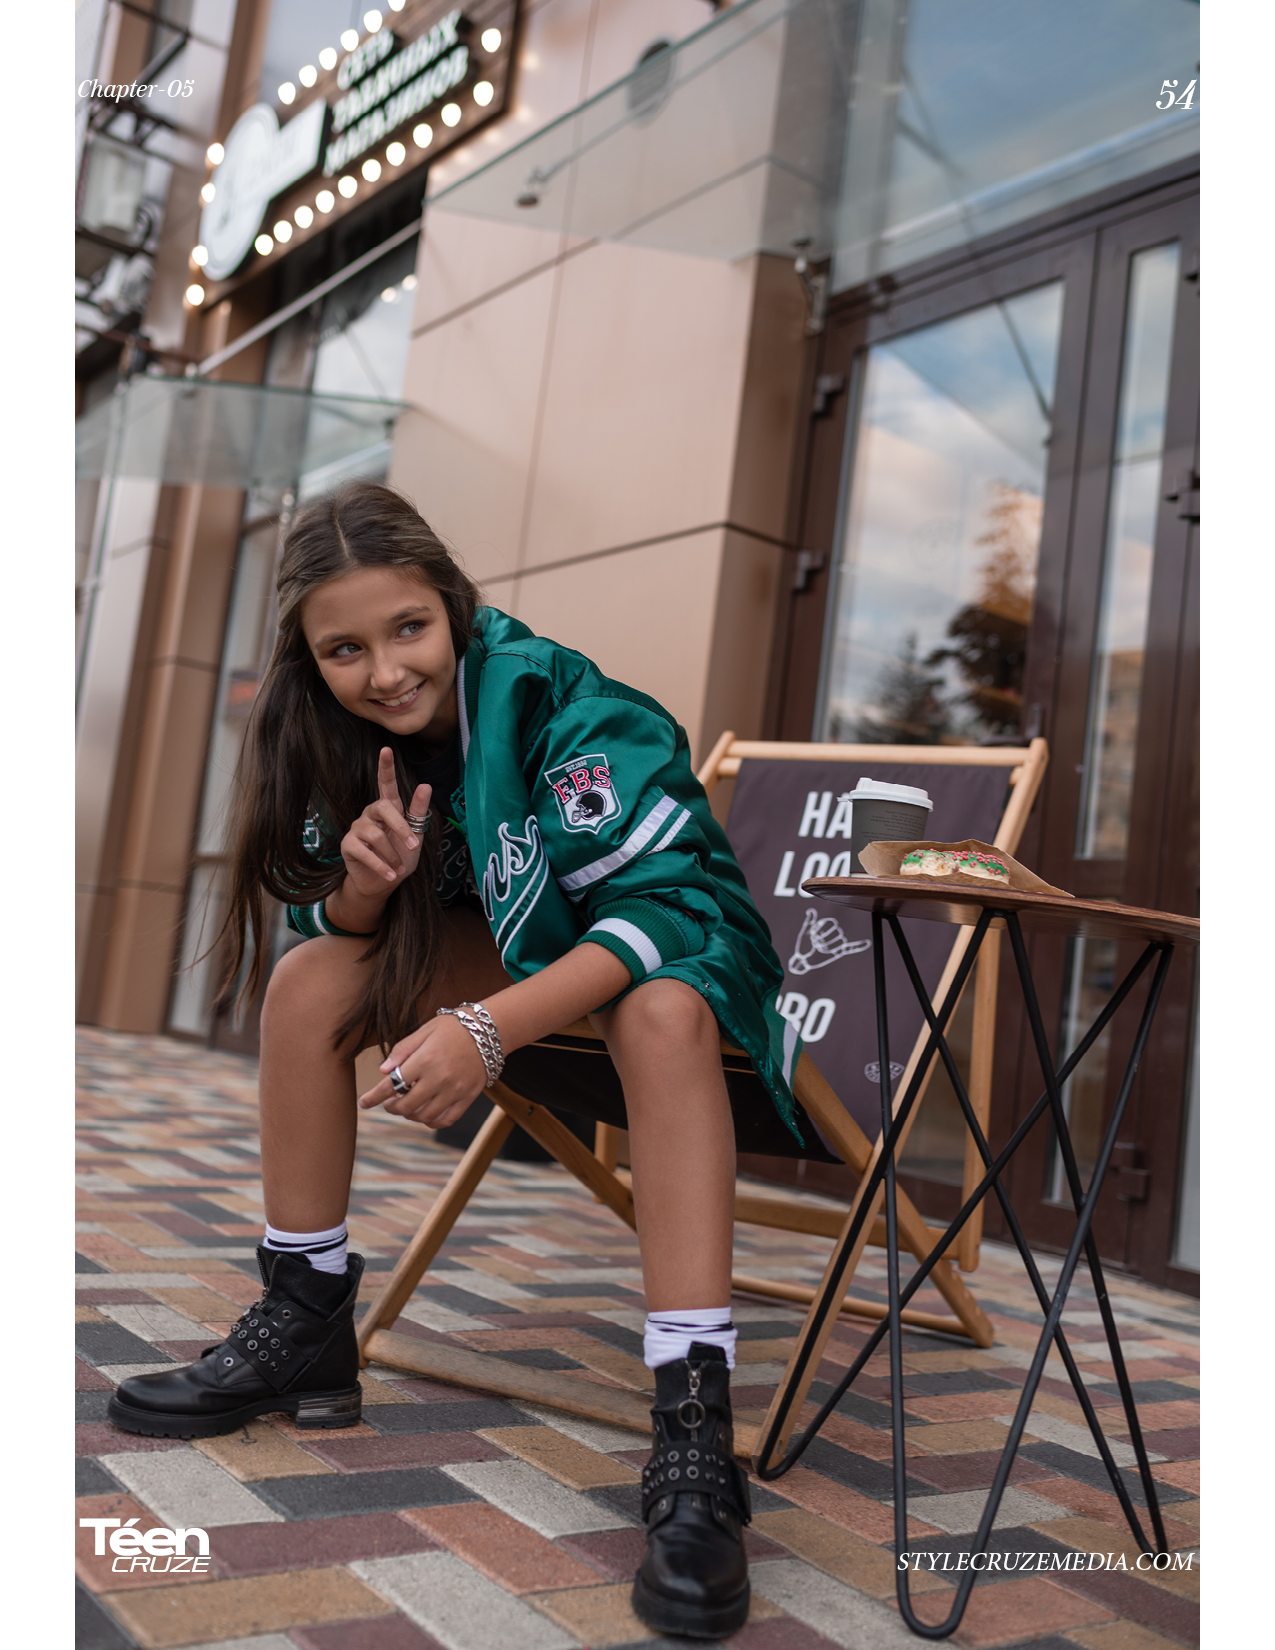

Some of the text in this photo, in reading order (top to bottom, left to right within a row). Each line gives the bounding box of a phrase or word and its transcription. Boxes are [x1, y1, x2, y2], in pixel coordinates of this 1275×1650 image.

[551, 764, 611, 805] FBS
[798, 791, 852, 839] HA
[775, 991, 836, 1043] RO
